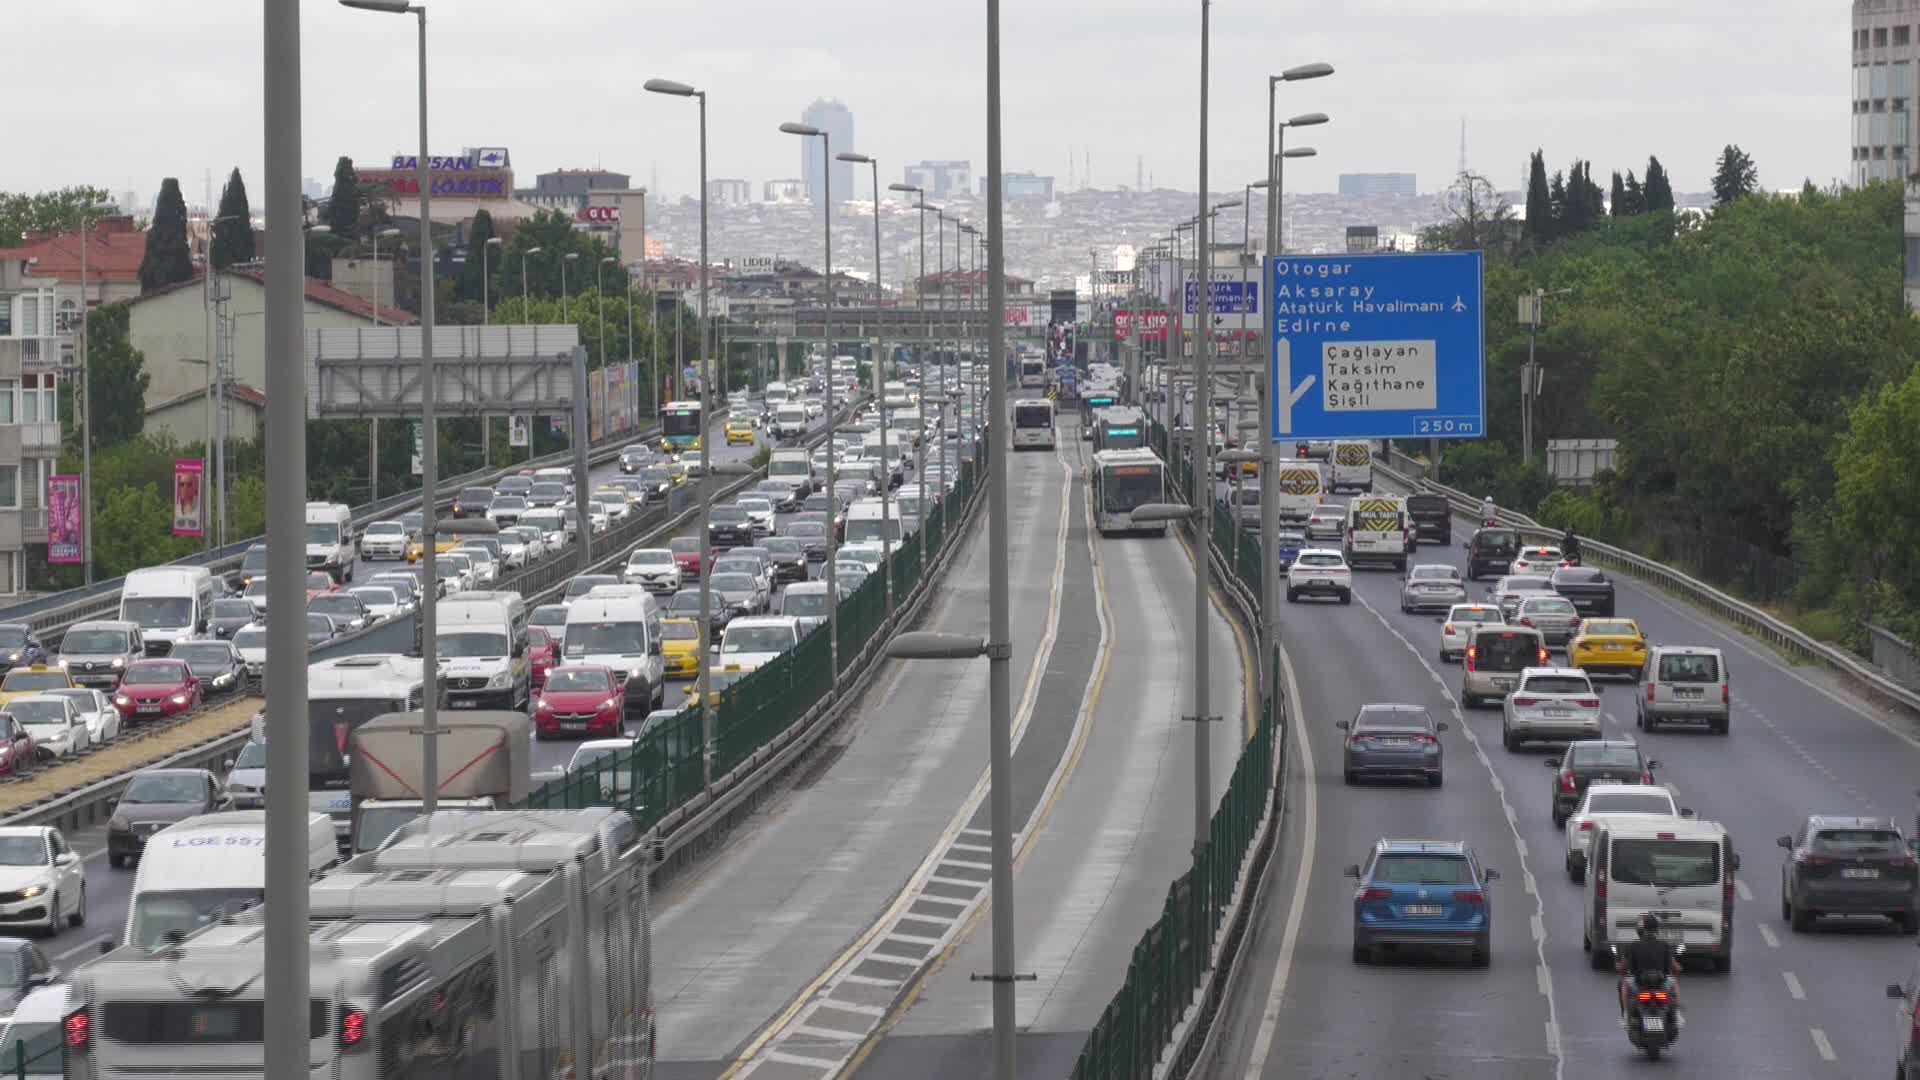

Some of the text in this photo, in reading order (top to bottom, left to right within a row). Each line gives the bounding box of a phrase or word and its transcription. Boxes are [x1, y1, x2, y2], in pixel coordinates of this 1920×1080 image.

[1277, 261, 1353, 278] Otogar
[1278, 284, 1375, 300] Aksaray
[1278, 300, 1444, 314] Atatürk Havalimanı
[1278, 319, 1352, 333] Edirne
[1327, 345, 1419, 361] Çağlayan
[1328, 363, 1396, 376] Taksim
[1328, 379, 1425, 394] Kağıthane
[1328, 393, 1370, 408] Şişli
[1420, 420, 1473, 432] 250 m
